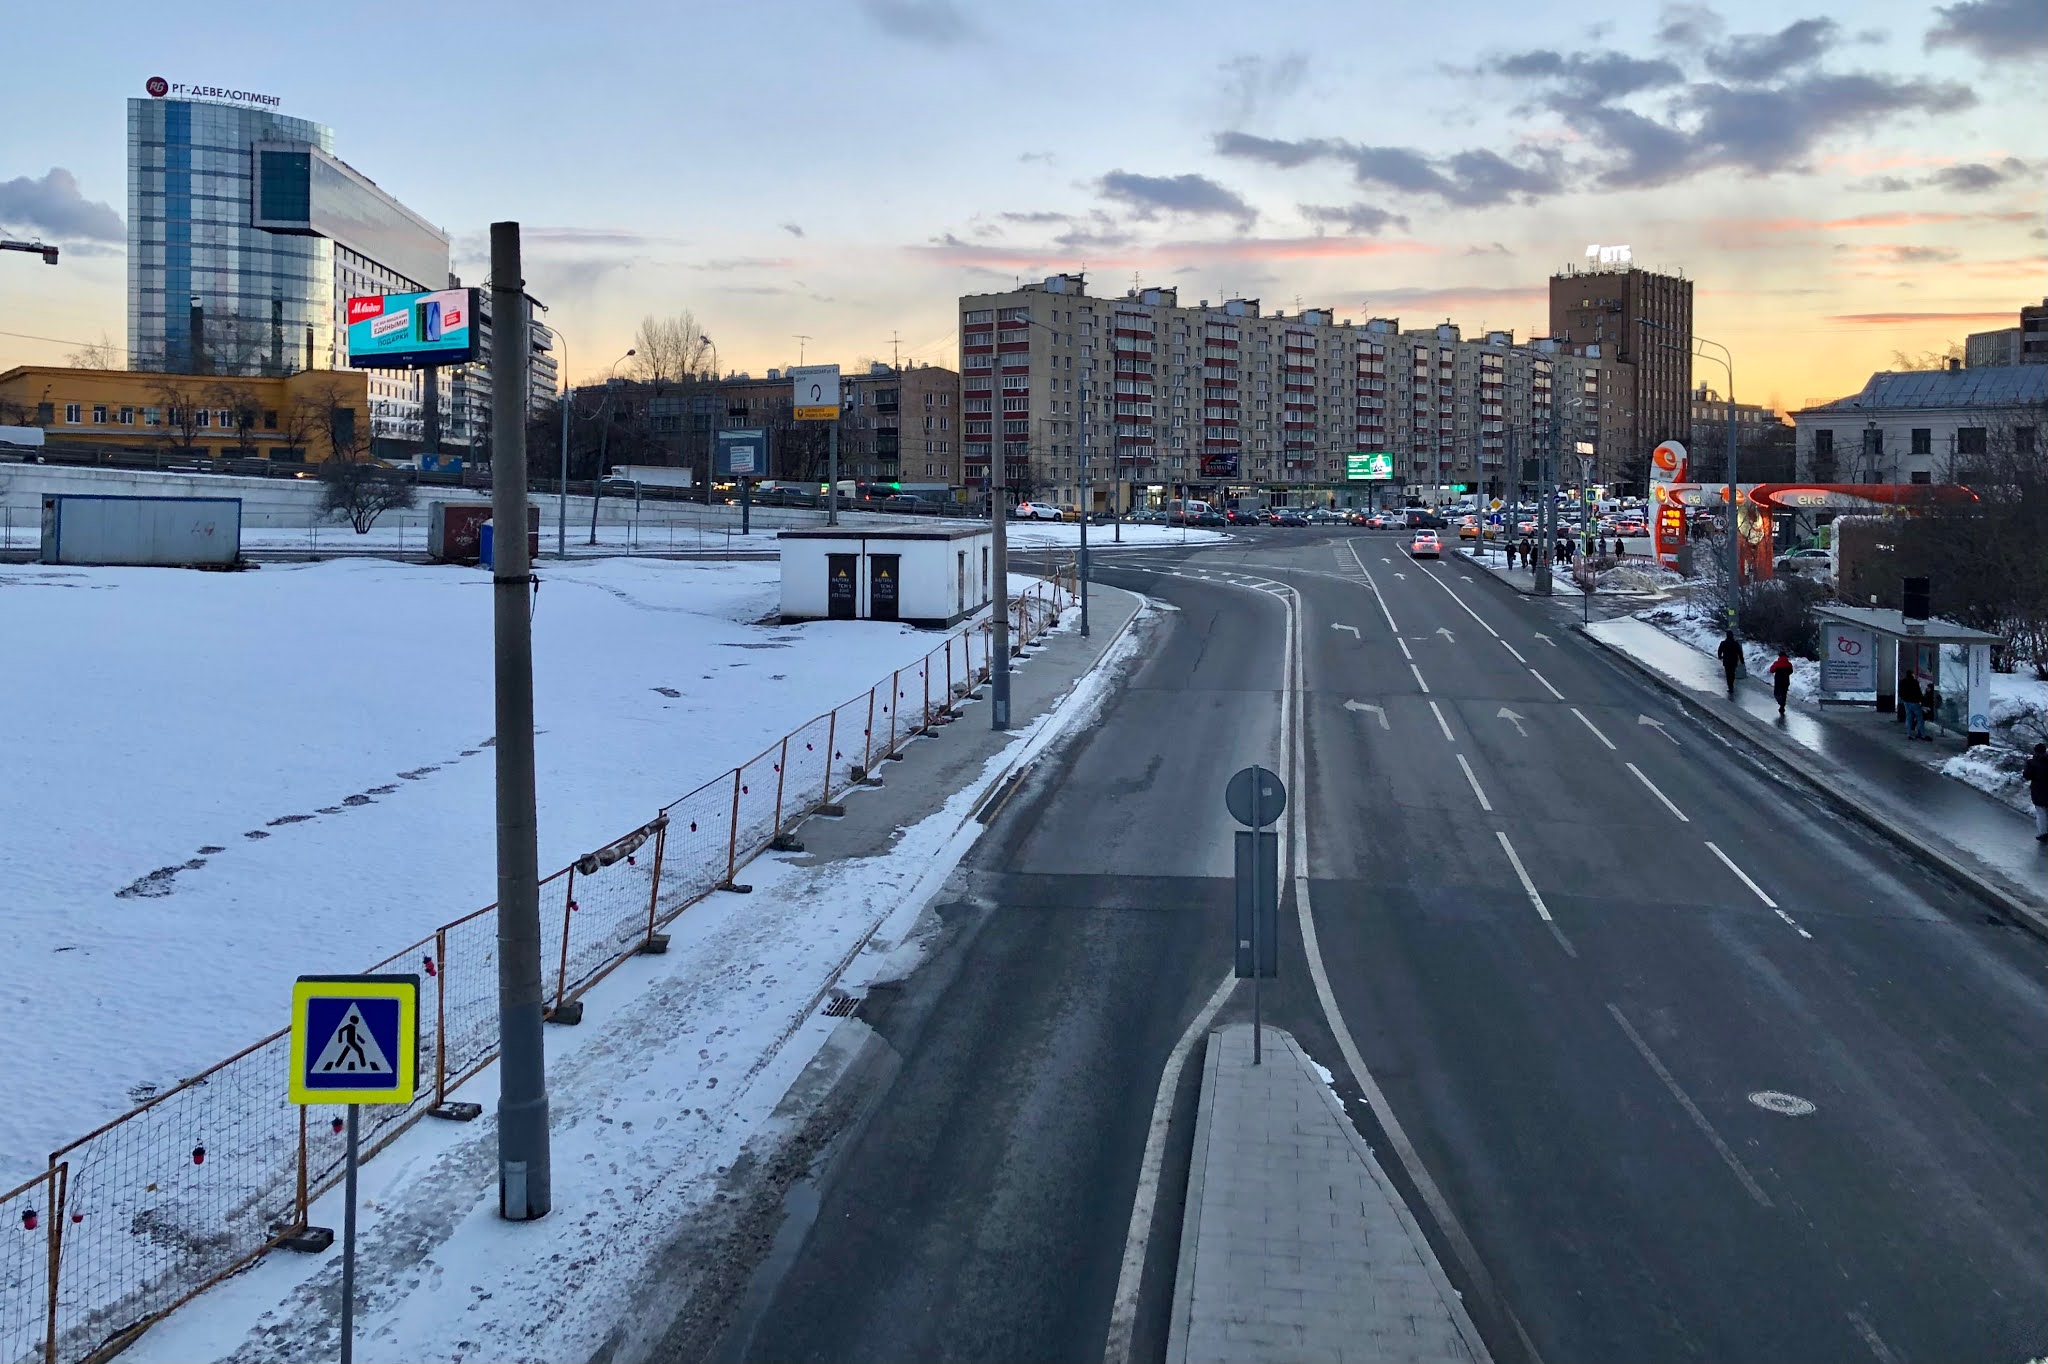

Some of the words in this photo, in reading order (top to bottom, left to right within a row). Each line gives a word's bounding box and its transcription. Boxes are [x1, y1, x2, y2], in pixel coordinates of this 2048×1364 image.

[172, 83, 281, 106] РГ-ДЕВЕЛОПМЕНТ
[374, 319, 408, 335] ЕДИНЫМИ!
[377, 332, 409, 347] ПОДАРКИ
